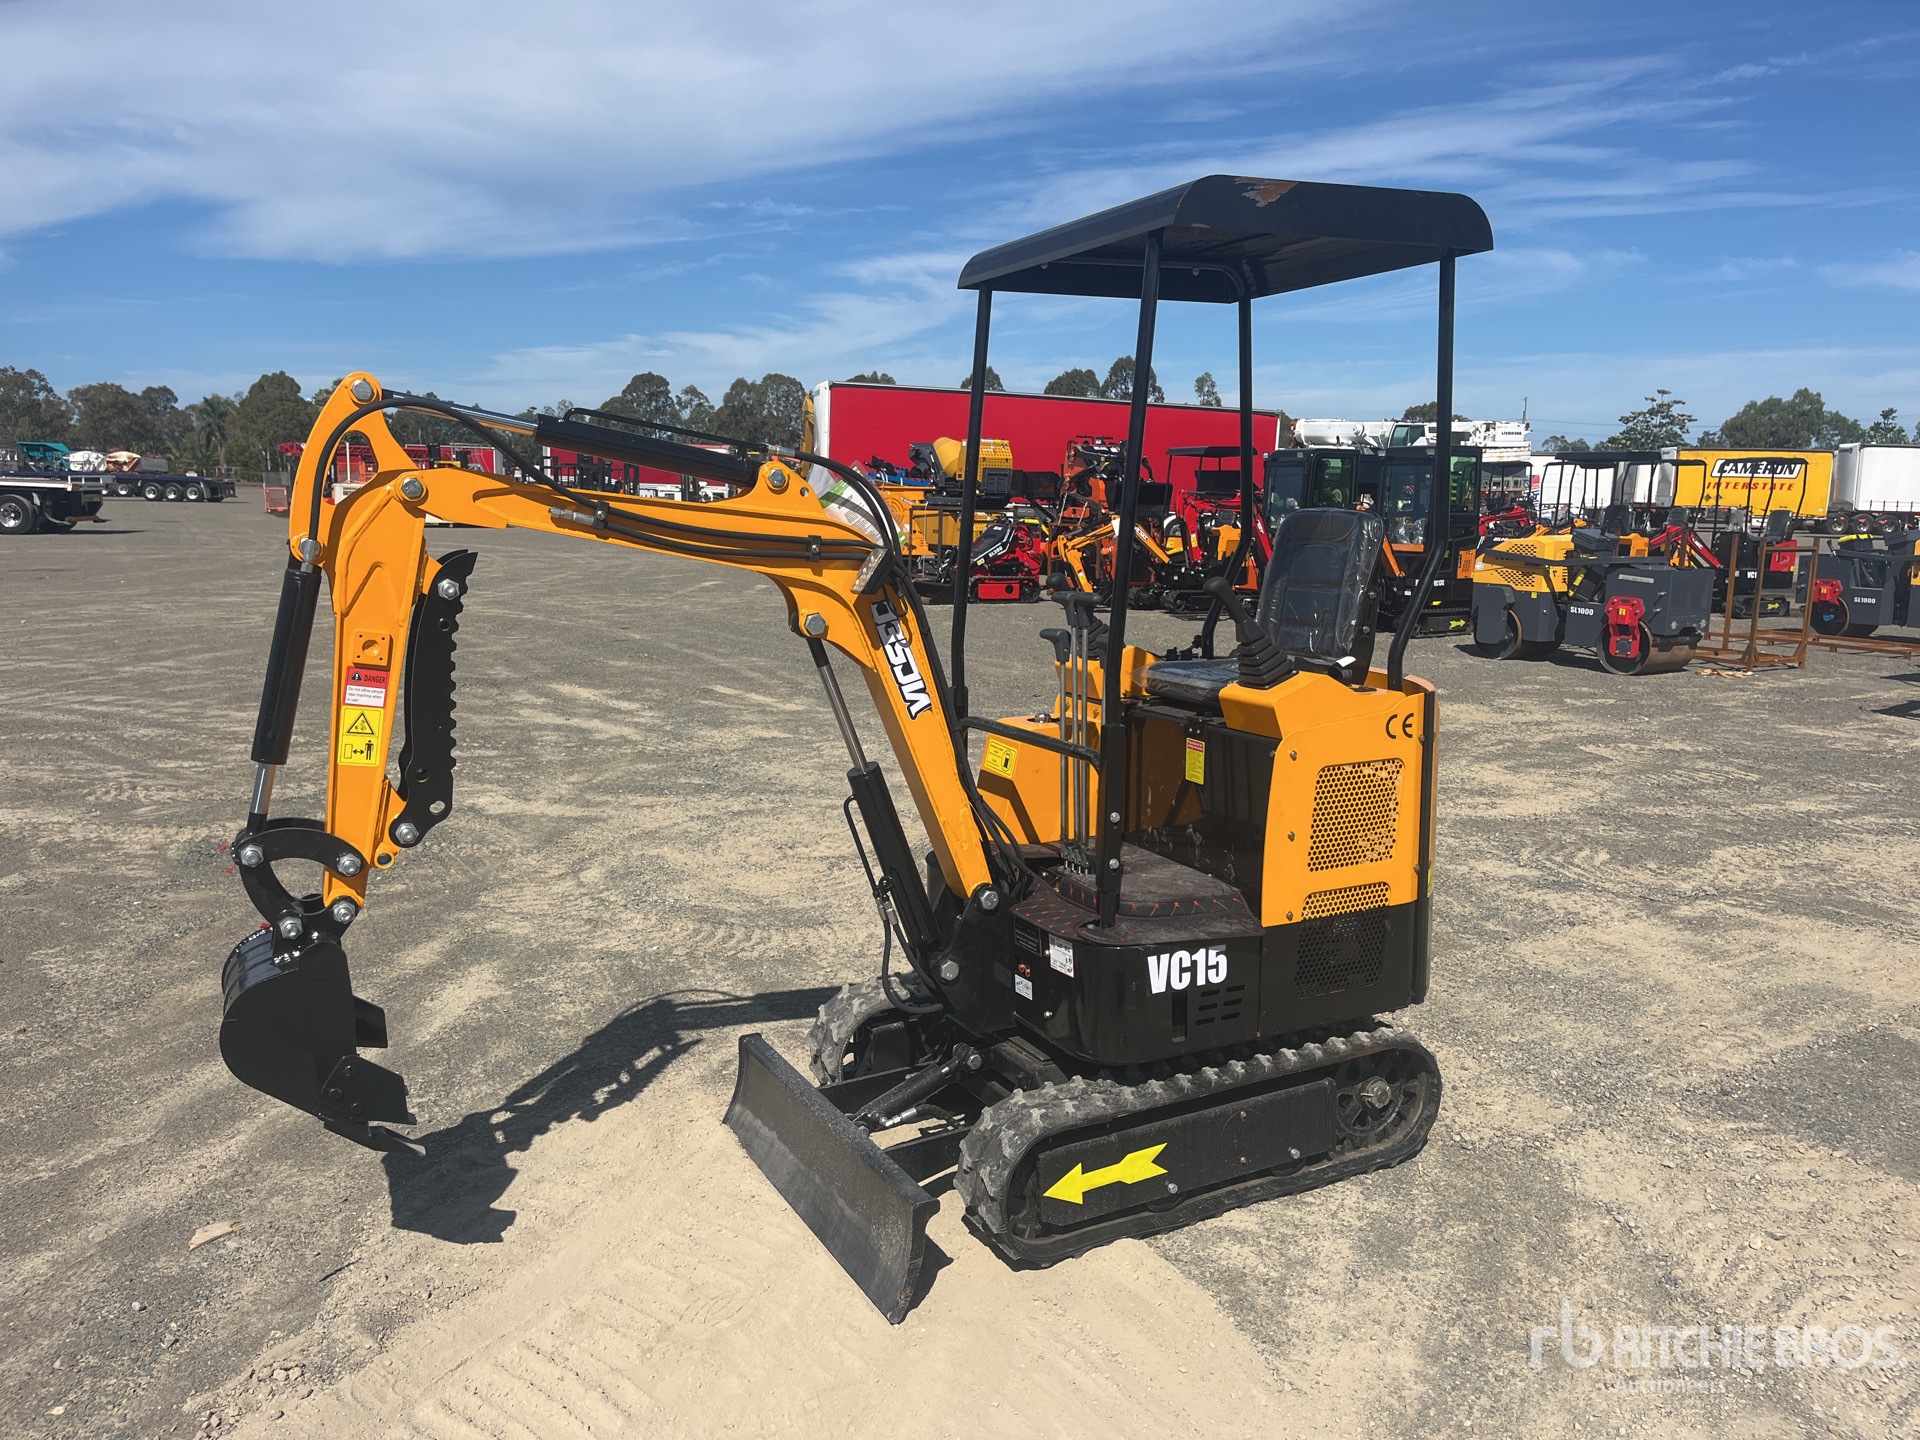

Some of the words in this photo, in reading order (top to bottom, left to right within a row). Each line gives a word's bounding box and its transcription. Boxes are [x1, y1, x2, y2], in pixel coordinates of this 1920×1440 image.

[1717, 460, 1796, 475] CAMERON
[1706, 481, 1795, 491] INTERSTATE
[1747, 571, 1758, 579] VC1
[1853, 596, 1876, 604] SL1000
[1570, 606, 1594, 616] SL1000
[364, 674, 386, 684] DANGER
[1386, 712, 1414, 739] CE
[1147, 945, 1228, 994] VC15
